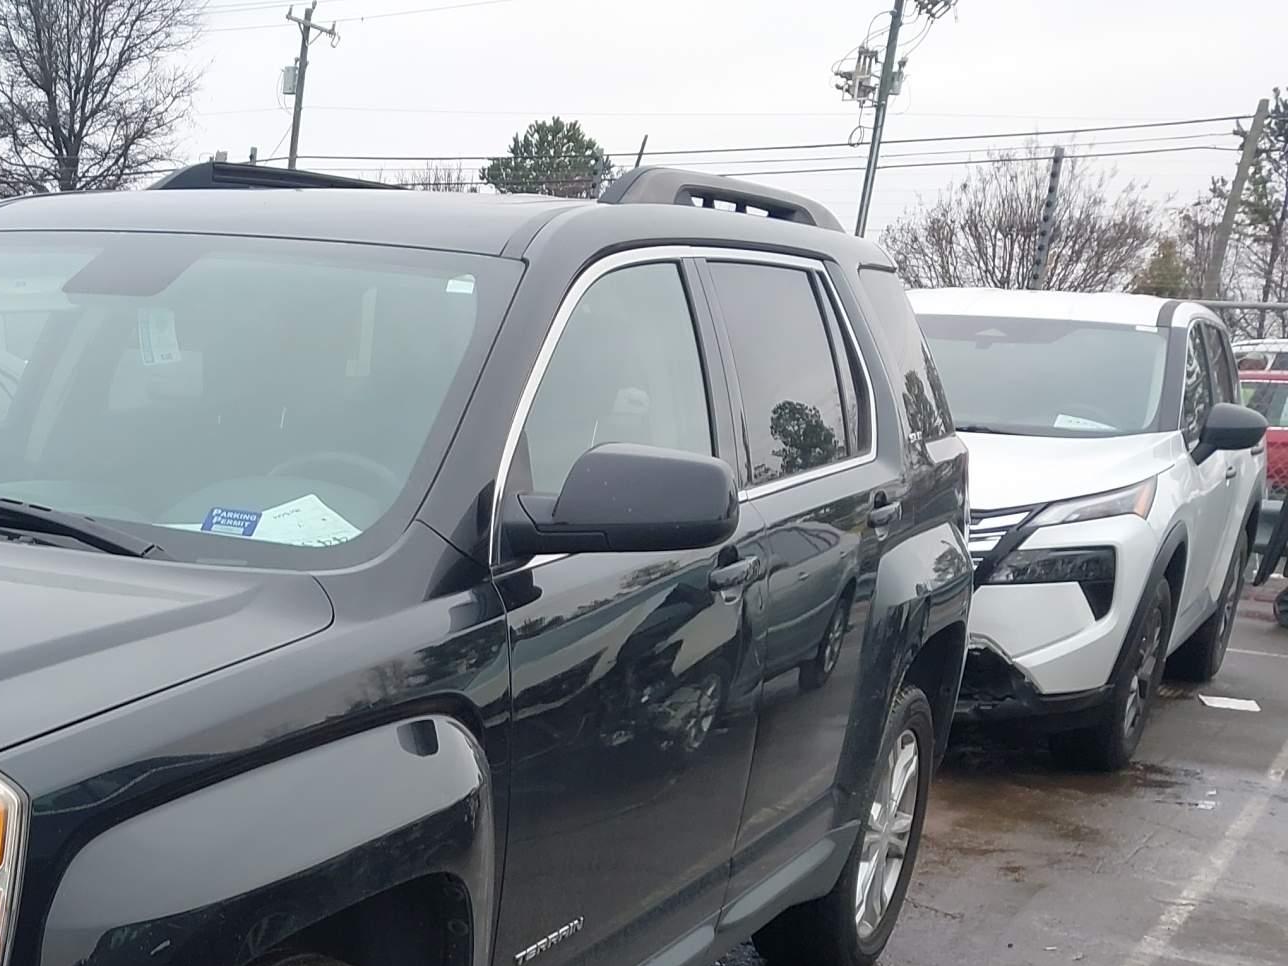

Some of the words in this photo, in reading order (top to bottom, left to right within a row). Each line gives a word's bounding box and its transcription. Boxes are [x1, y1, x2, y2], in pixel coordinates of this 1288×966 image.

[212, 508, 257, 522] PARKING
[212, 516, 251, 529] PERMIT
[515, 916, 583, 966] TERRAIN
